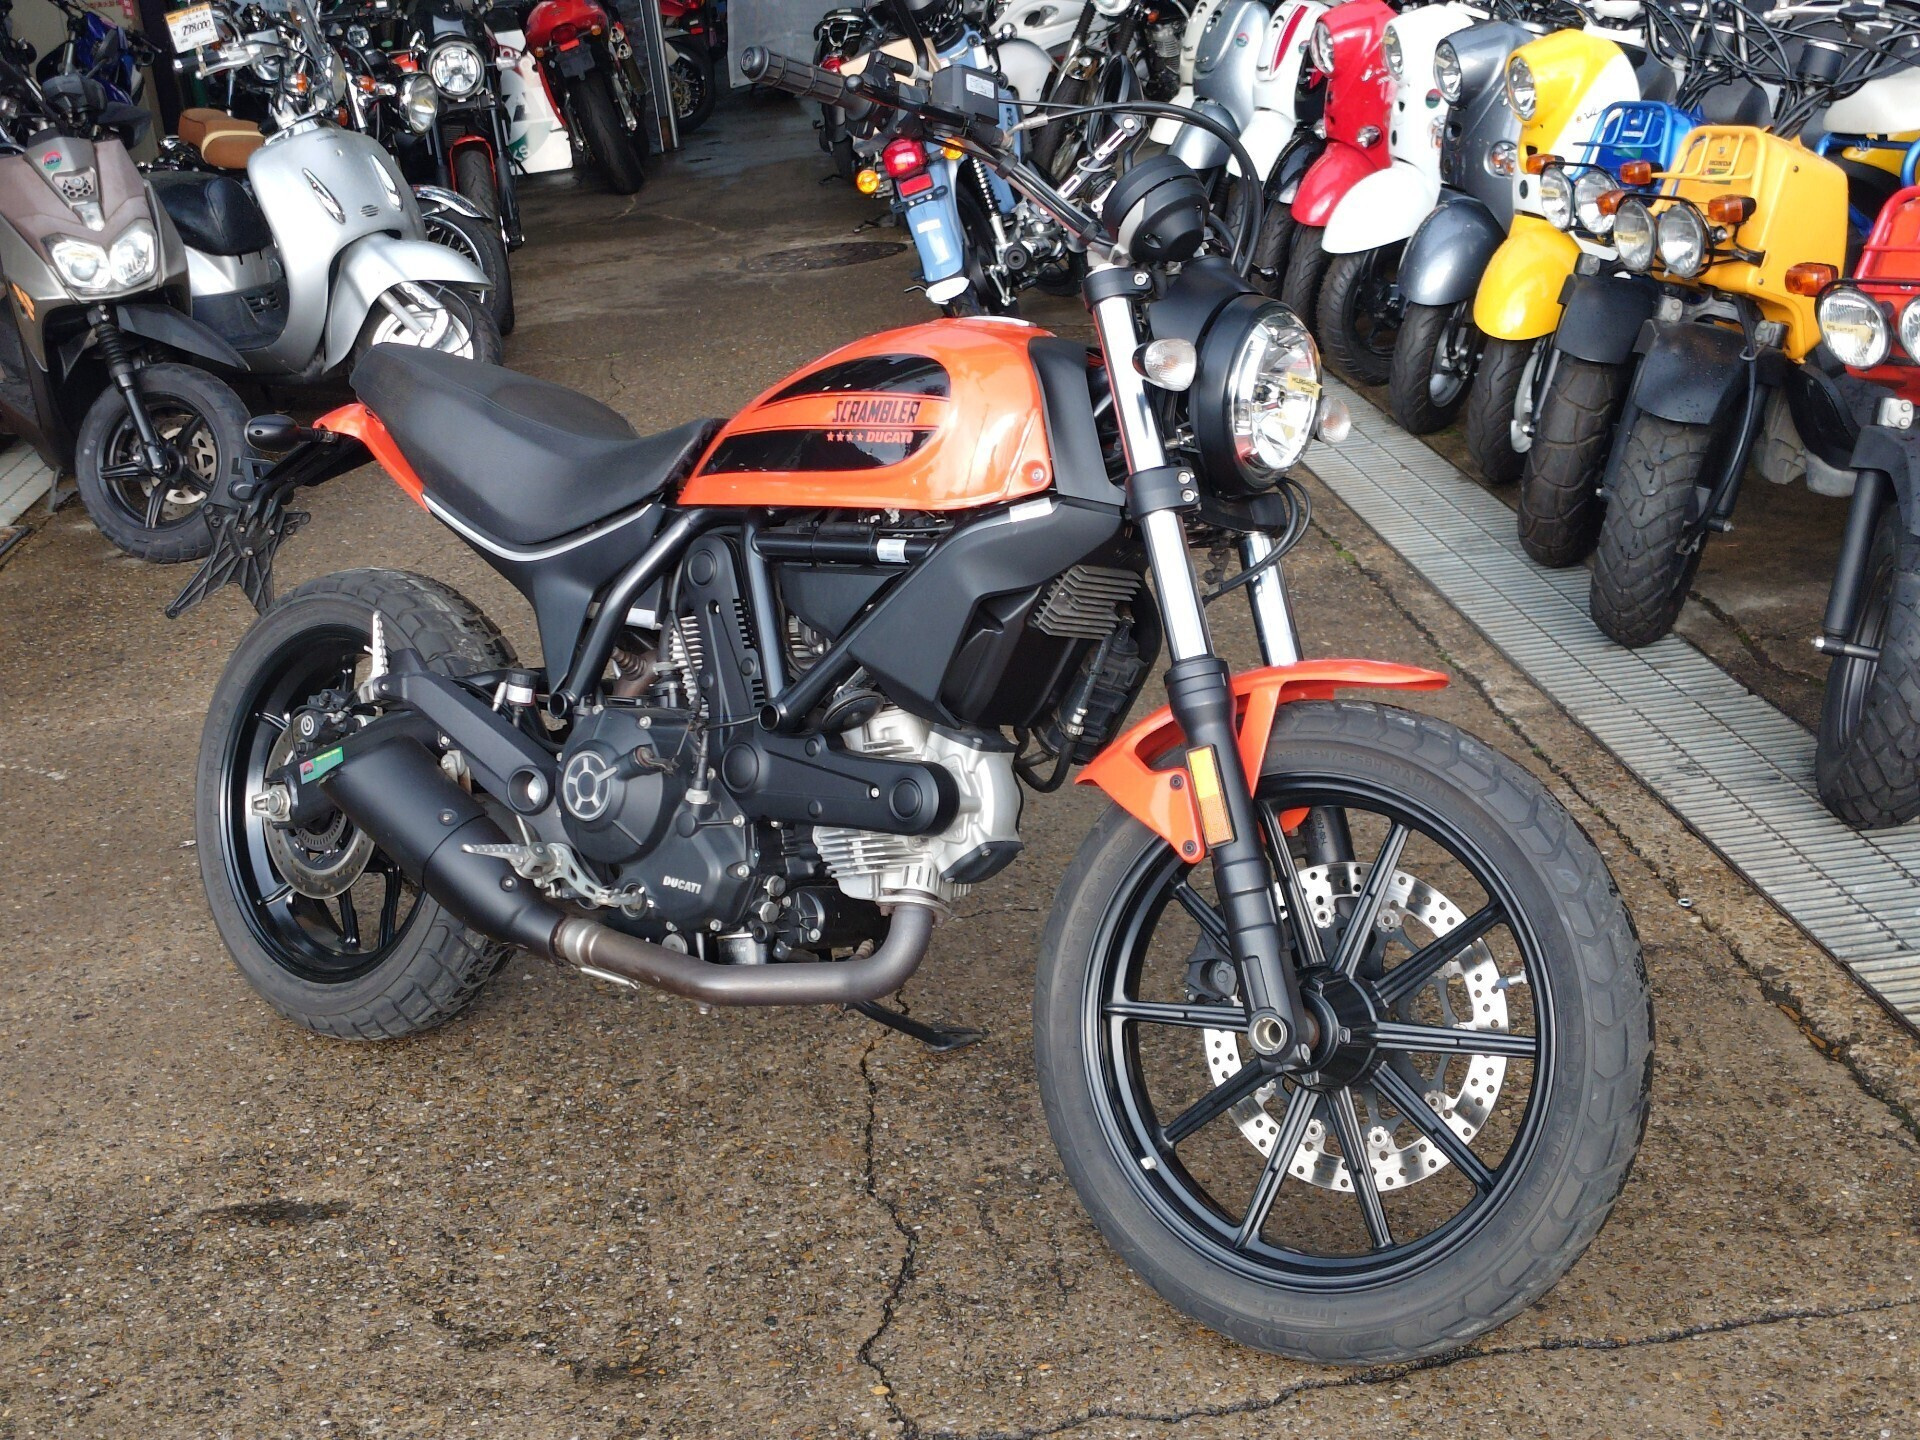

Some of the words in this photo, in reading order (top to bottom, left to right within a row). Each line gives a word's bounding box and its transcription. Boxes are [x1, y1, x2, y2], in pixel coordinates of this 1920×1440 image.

[832, 400, 921, 424] SCRAMBLER
[866, 431, 914, 444] DUCATI
[663, 875, 702, 895] DUCATI
